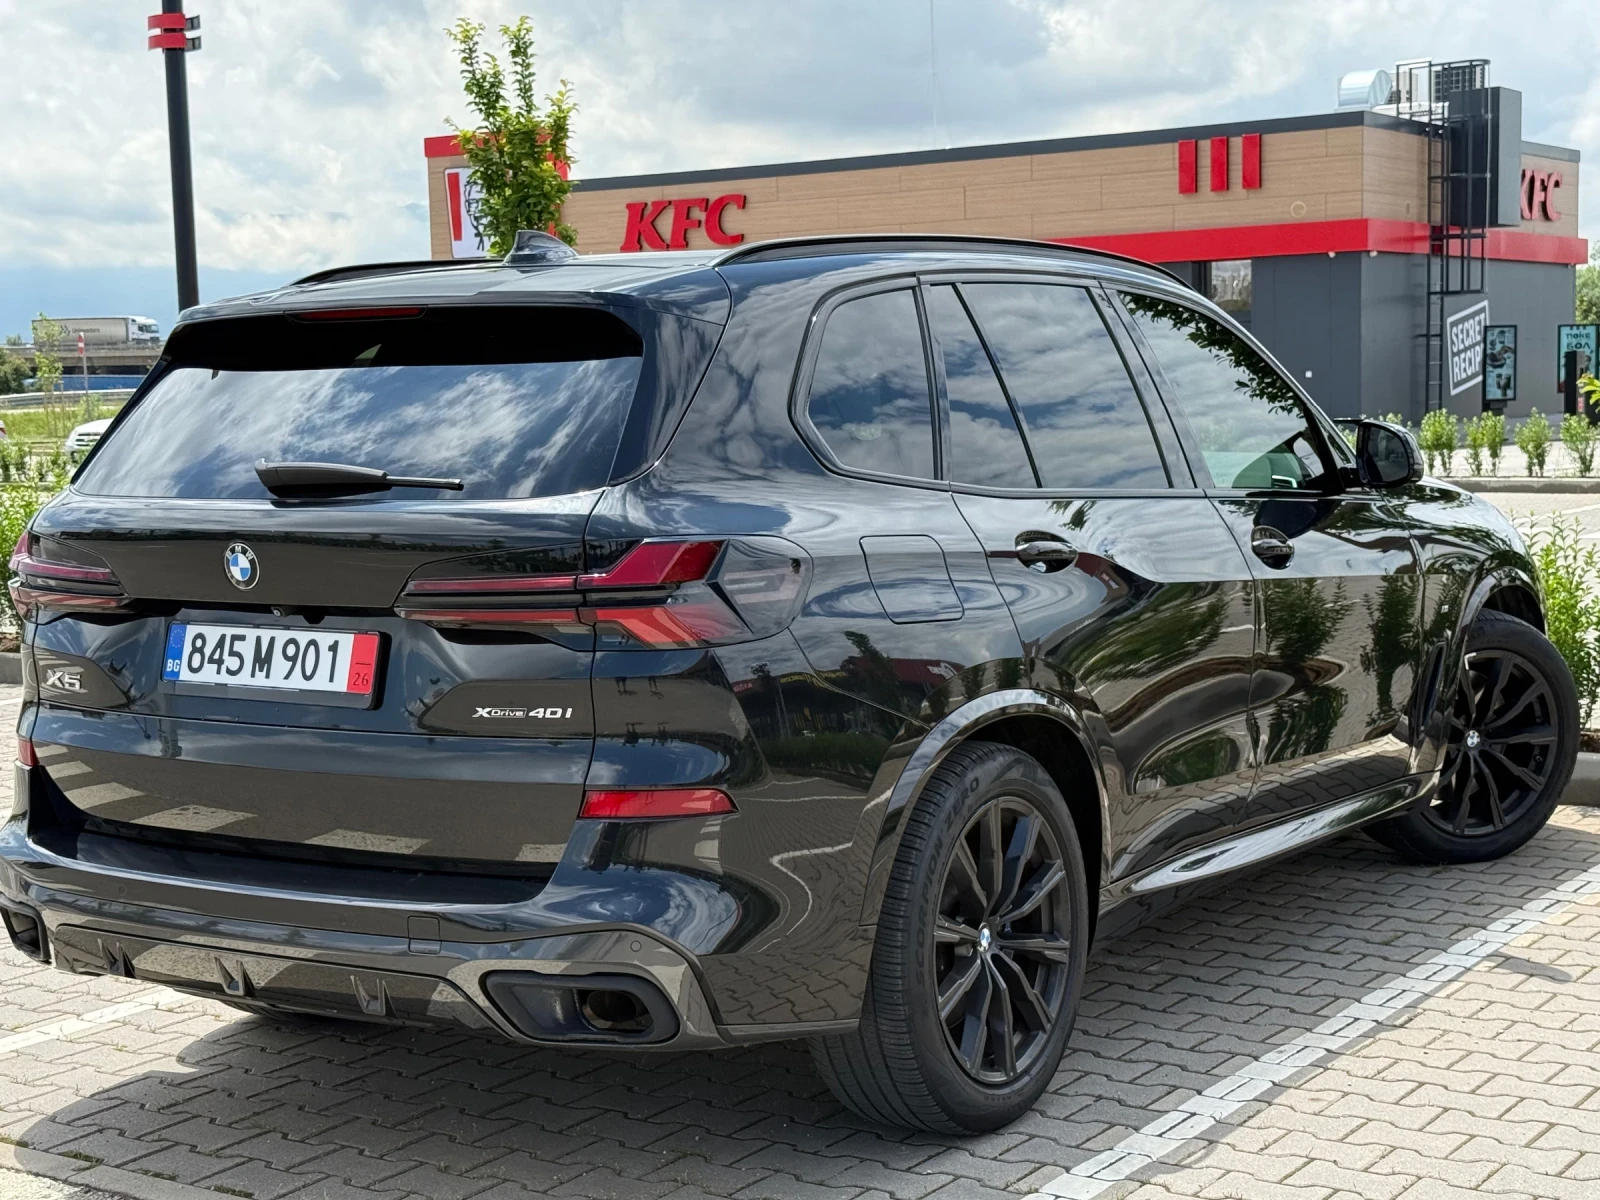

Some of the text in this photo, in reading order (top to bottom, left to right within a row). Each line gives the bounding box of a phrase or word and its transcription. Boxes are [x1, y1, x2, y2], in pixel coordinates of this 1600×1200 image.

[620, 193, 748, 252] KFC
[1451, 312, 1486, 353] SECRET
[46, 669, 81, 691] X5
[166, 658, 180, 672] BG
[353, 672, 369, 686] 26
[916, 777, 980, 983] SCORPION ZERO
